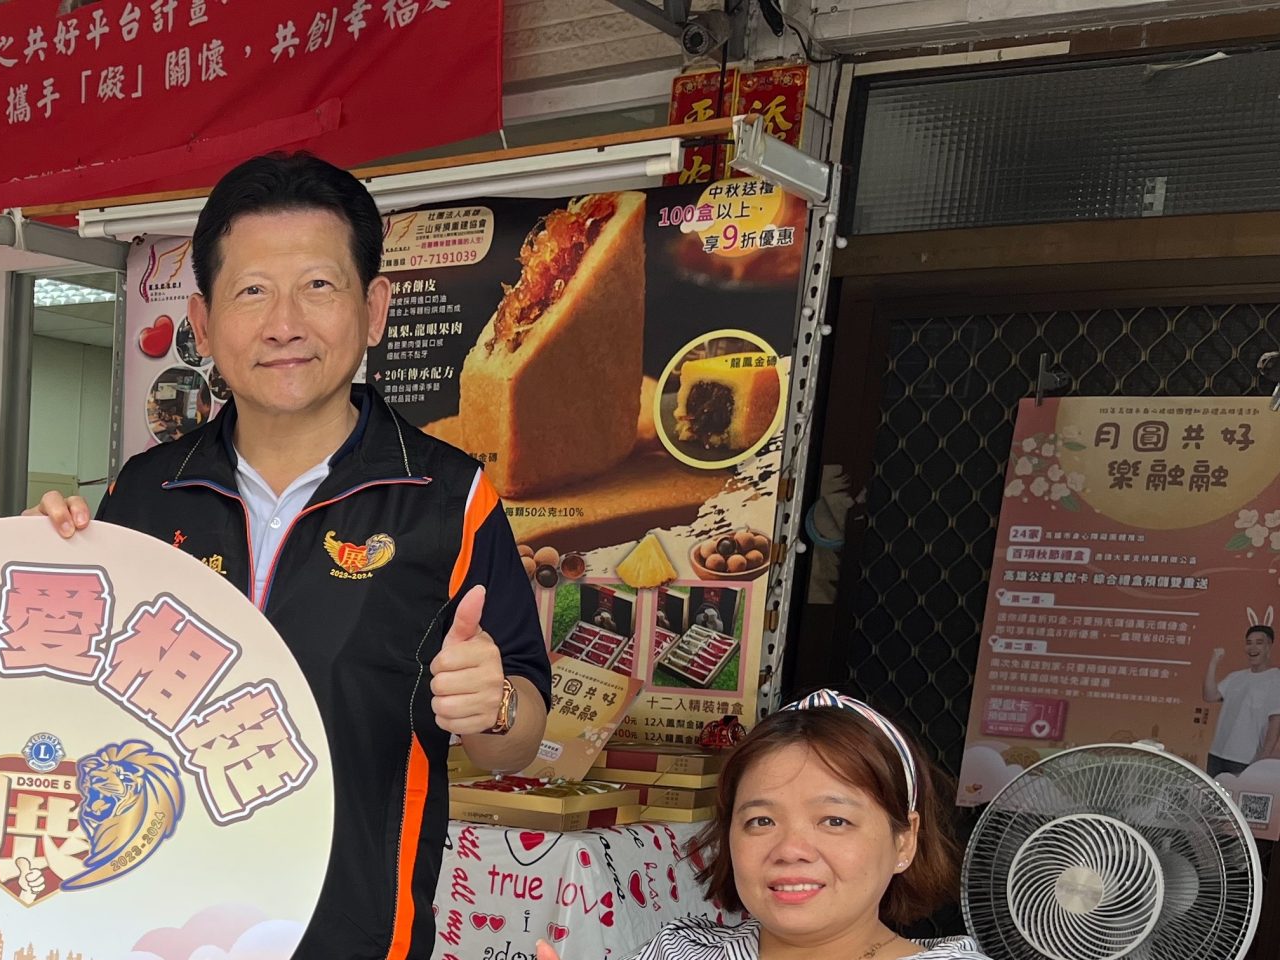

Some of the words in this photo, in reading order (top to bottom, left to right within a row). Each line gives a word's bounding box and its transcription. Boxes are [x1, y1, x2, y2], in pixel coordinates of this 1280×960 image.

[708, 180, 774, 199] 中秋送禮
[703, 224, 796, 252] 享9折優惠
[410, 250, 477, 267] 07-7191039
[1094, 420, 1255, 452] 月圓共好
[1108, 459, 1229, 492] 樂融融
[1012, 528, 1039, 540] 24家
[646, 696, 744, 715] 十二入精裝禮盒
[16, 776, 59, 789] D300E
[111, 811, 166, 871] 2023-2024
[488, 864, 543, 901] true
[439, 909, 463, 946] my
